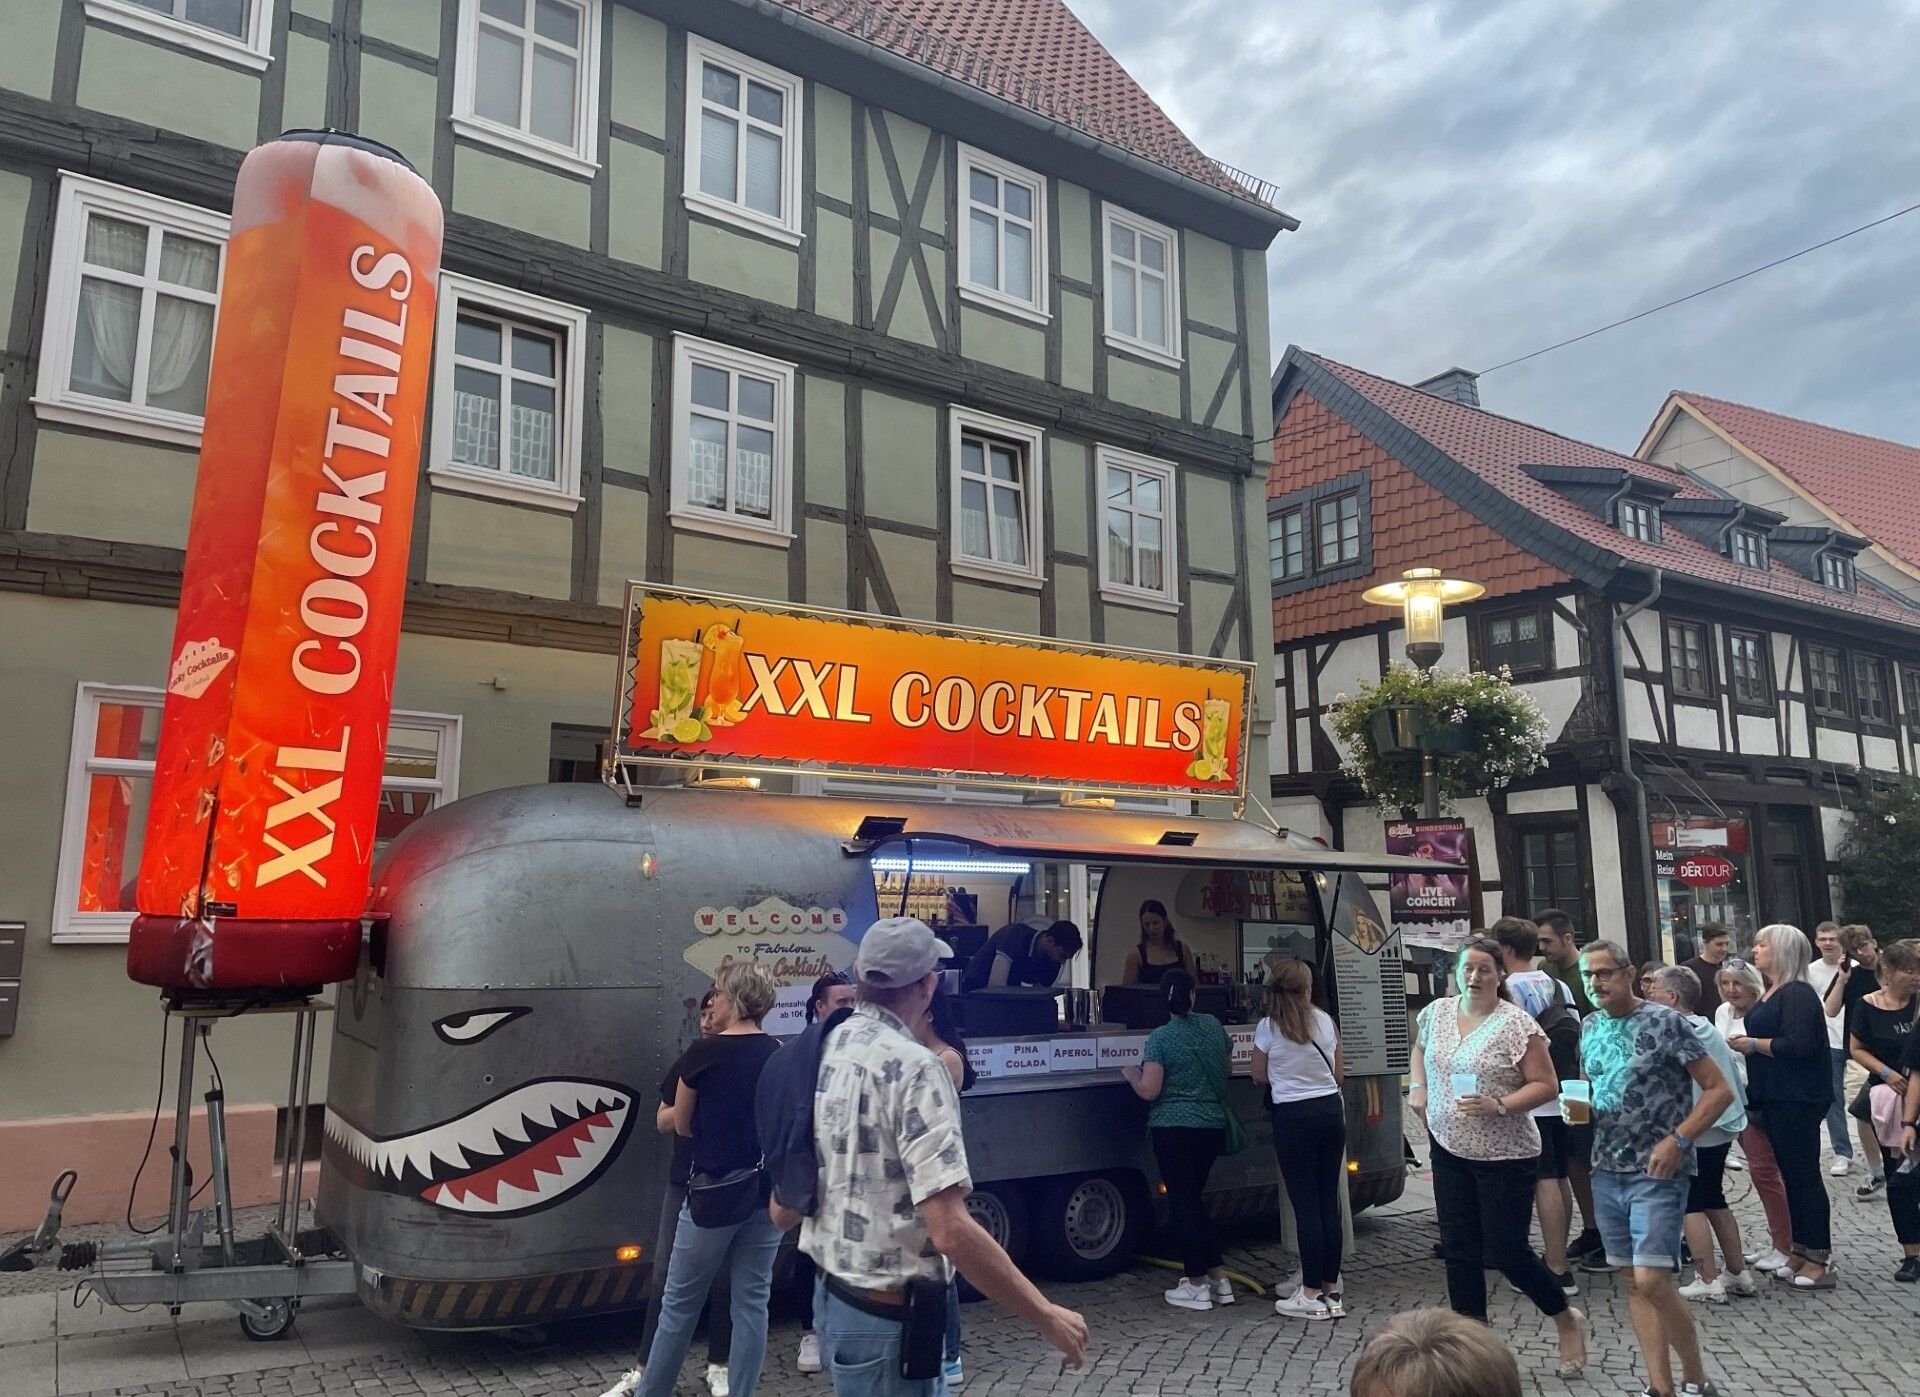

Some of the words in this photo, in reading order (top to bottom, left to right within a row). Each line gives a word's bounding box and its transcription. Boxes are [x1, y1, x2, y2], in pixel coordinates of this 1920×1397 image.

[291, 243, 413, 697] COCKTAILS
[742, 652, 873, 724] XXL
[890, 670, 1202, 753] COCKTAILS
[255, 725, 351, 889] XXL
[1655, 850, 1674, 861] Mein
[1680, 861, 1730, 878] DERTOUR
[1419, 886, 1444, 897] LIVE
[1406, 896, 1457, 907] CONCERT
[700, 913, 842, 926] WELCOME
[737, 945, 750, 954] TO
[752, 943, 816, 956] Fabulous
[1230, 1034, 1255, 1043] CUB
[1053, 1048, 1094, 1058] APEROL
[1101, 1048, 1139, 1058] MOJITO
[1005, 1059, 1047, 1069] COLADA
